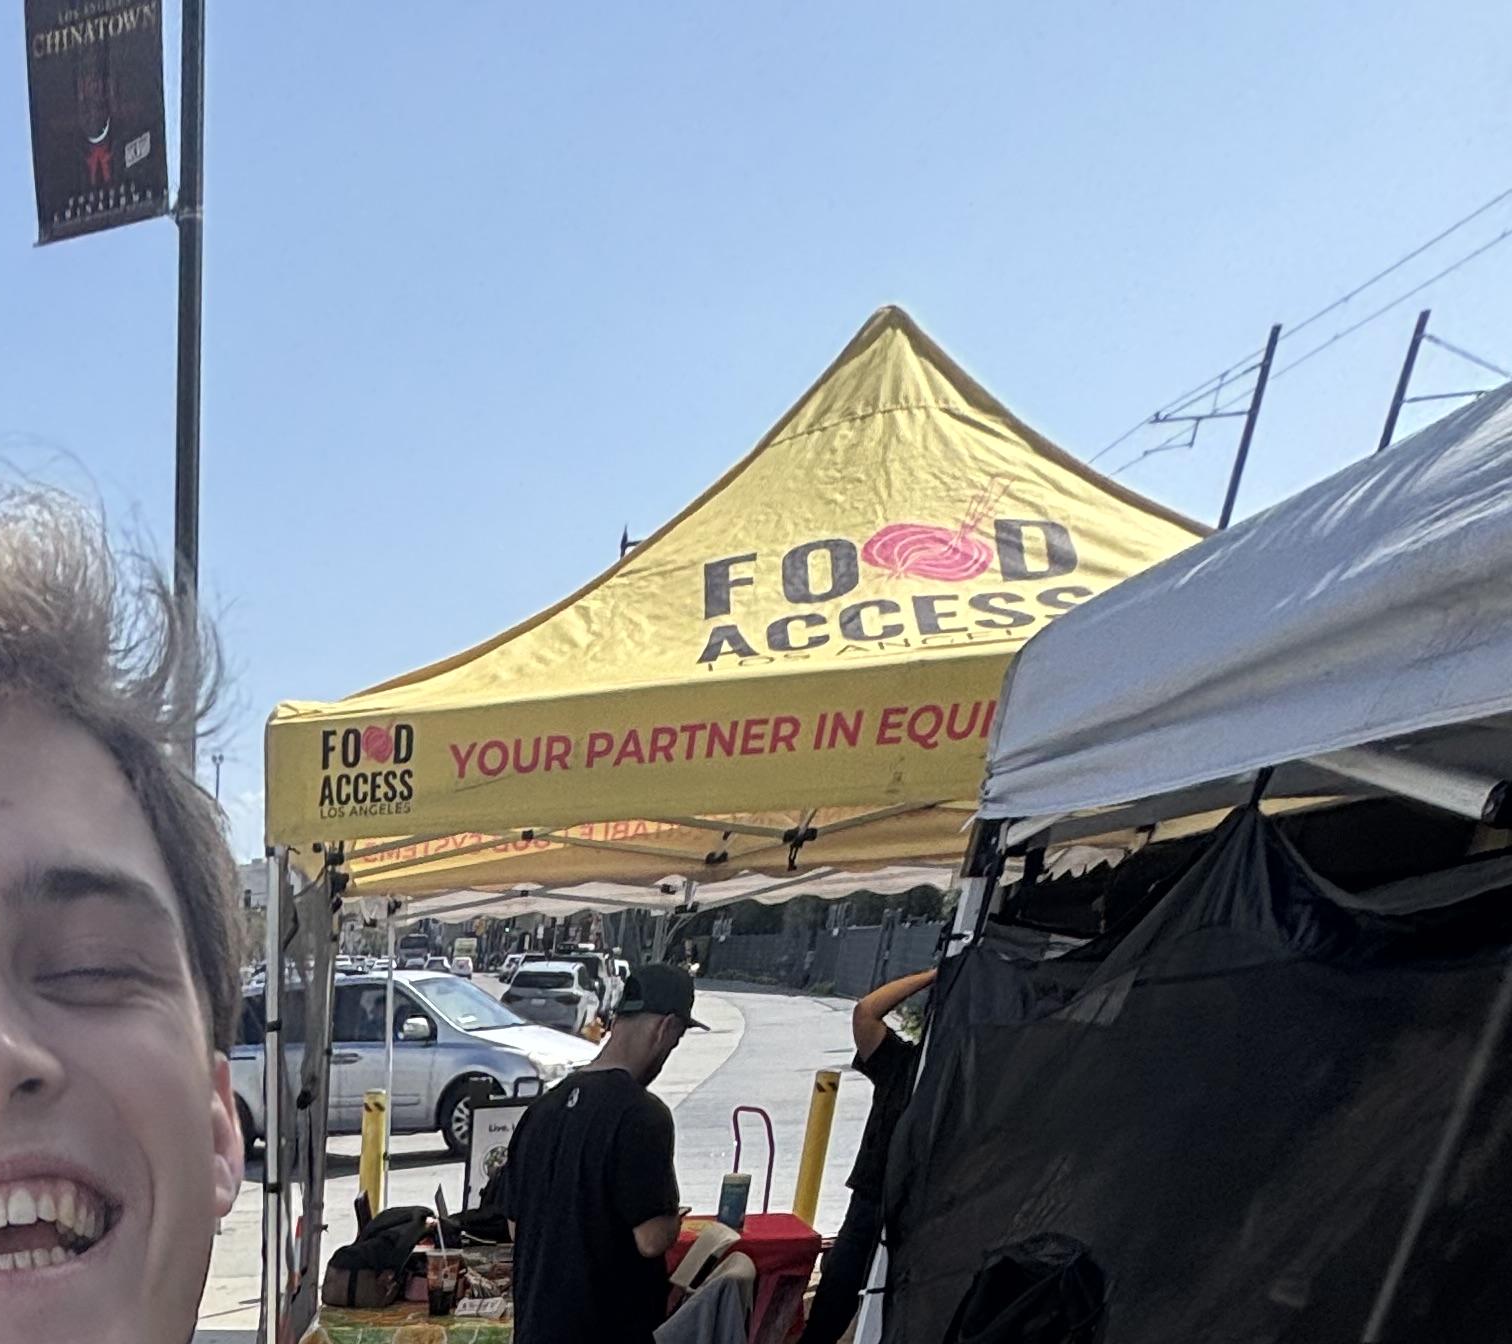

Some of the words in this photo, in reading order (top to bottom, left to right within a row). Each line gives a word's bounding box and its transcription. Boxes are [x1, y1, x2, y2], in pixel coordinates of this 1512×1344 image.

[33, 2, 157, 58] CHINATOWN
[696, 585, 1094, 665] ACCESS
[449, 734, 573, 779] YOUR
[585, 715, 802, 769] PARTNER
[812, 709, 865, 751] IN
[319, 768, 414, 807] ACCESS
[320, 806, 345, 819] LOS
[349, 801, 411, 817] ANGELES
